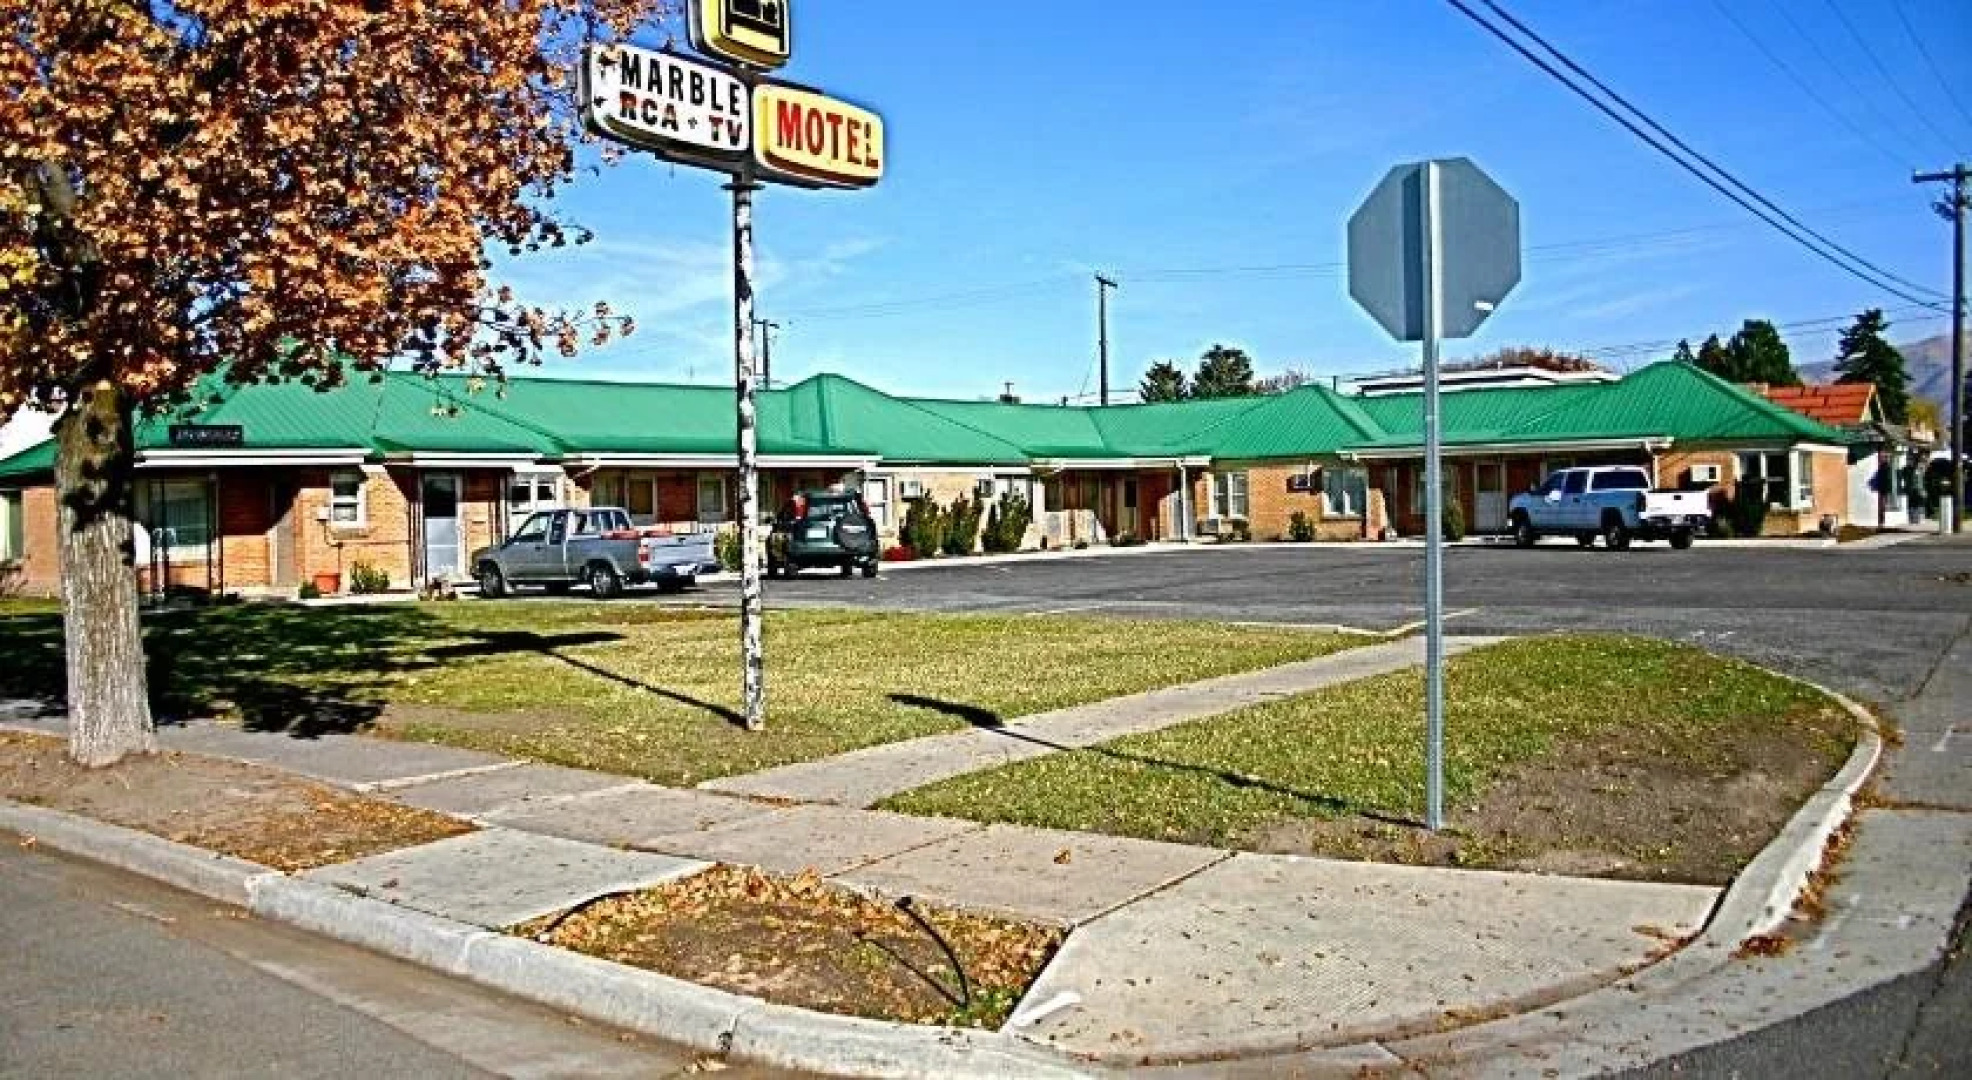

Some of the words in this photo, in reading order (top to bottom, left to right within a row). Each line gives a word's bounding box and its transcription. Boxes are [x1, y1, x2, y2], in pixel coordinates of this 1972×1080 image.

[620, 51, 741, 116] MARBLE
[619, 91, 679, 132] RCA
[708, 115, 743, 146] TV
[776, 100, 879, 169] MOTEL
